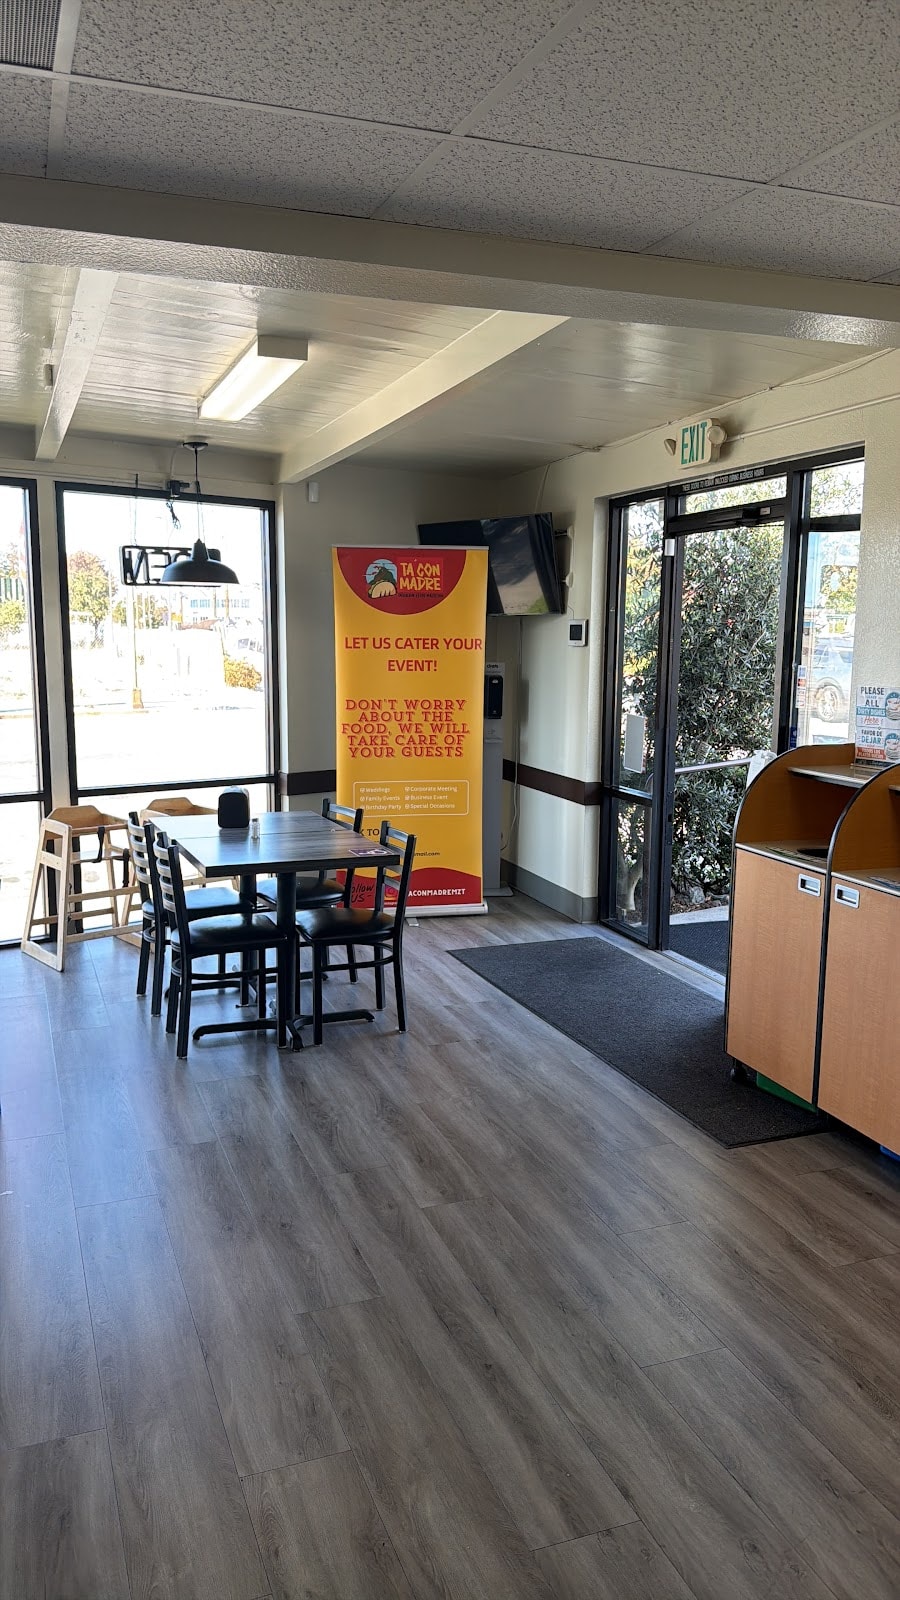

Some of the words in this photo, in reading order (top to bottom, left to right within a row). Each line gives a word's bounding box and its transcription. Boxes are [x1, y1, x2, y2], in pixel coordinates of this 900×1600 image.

[681, 421, 708, 465] EXIT
[400, 577, 442, 591] MADRE
[345, 637, 369, 649] LET
[372, 637, 391, 650] US
[394, 638, 440, 650] CATER
[443, 638, 482, 651] YOUR
[387, 659, 438, 672] EVENT!
[861, 687, 884, 695] PLEASE
[345, 699, 398, 711] DON'T
[404, 699, 466, 711] WORRY
[865, 699, 880, 708] ALL
[358, 711, 416, 722] ABOUT
[422, 711, 453, 722] THE
[342, 723, 392, 735] FOOD,
[398, 723, 424, 734] WE
[430, 723, 470, 734] WILL
[347, 735, 389, 746] TAKE
[395, 734, 438, 745] CARE
[444, 734, 465, 745] OF
[861, 735, 881, 745] DEJAR
[348, 747, 395, 758] YOUR
[401, 746, 464, 758] GUESTS
[410, 786, 436, 794] Corporate
[351, 882, 375, 893] ollow
